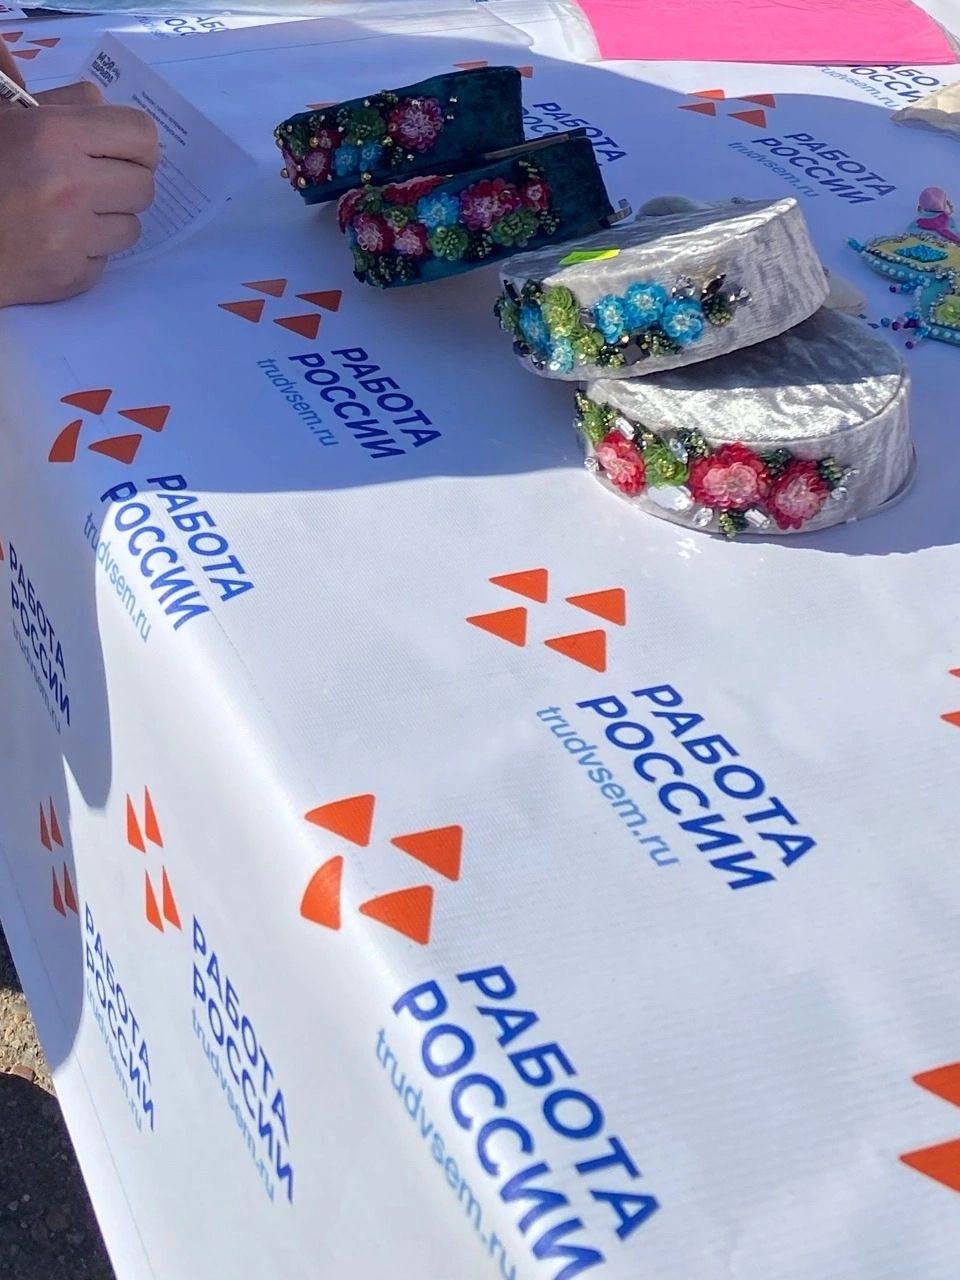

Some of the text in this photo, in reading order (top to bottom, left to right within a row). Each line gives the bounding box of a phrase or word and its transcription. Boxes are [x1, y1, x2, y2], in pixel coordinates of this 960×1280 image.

[532, 102, 627, 162] РАБОТА
[850, 67, 924, 103] ОССИ
[728, 141, 820, 198] trudvsem.ru
[751, 137, 876, 205] РОССИИ
[783, 133, 897, 197] РАБОТА
[256, 357, 340, 447] trudvsem.ru
[287, 353, 407, 459] РОССИИ
[330, 347, 442, 448] РАБОТА
[9, 541, 66, 681] РАБОТА
[83, 512, 152, 643] trudvsem.ru
[100, 481, 210, 631] РОССИИ
[146, 474, 255, 602] РАБОТА
[10, 580, 70, 727] РОССИИ
[535, 705, 680, 867] trudvsem.ru
[576, 695, 777, 891] РОССИИ
[631, 684, 817, 868] РАБОТА
[86, 901, 152, 1086] РАБОТА
[86, 941, 154, 1132] РОССИИ
[193, 914, 290, 1146] РАБОТА
[193, 961, 293, 1204] РОССИИ
[376, 1028, 517, 1279] trudvsem.ru
[392, 979, 607, 1279] РОССИИ
[455, 964, 661, 1242] РАБОТА
